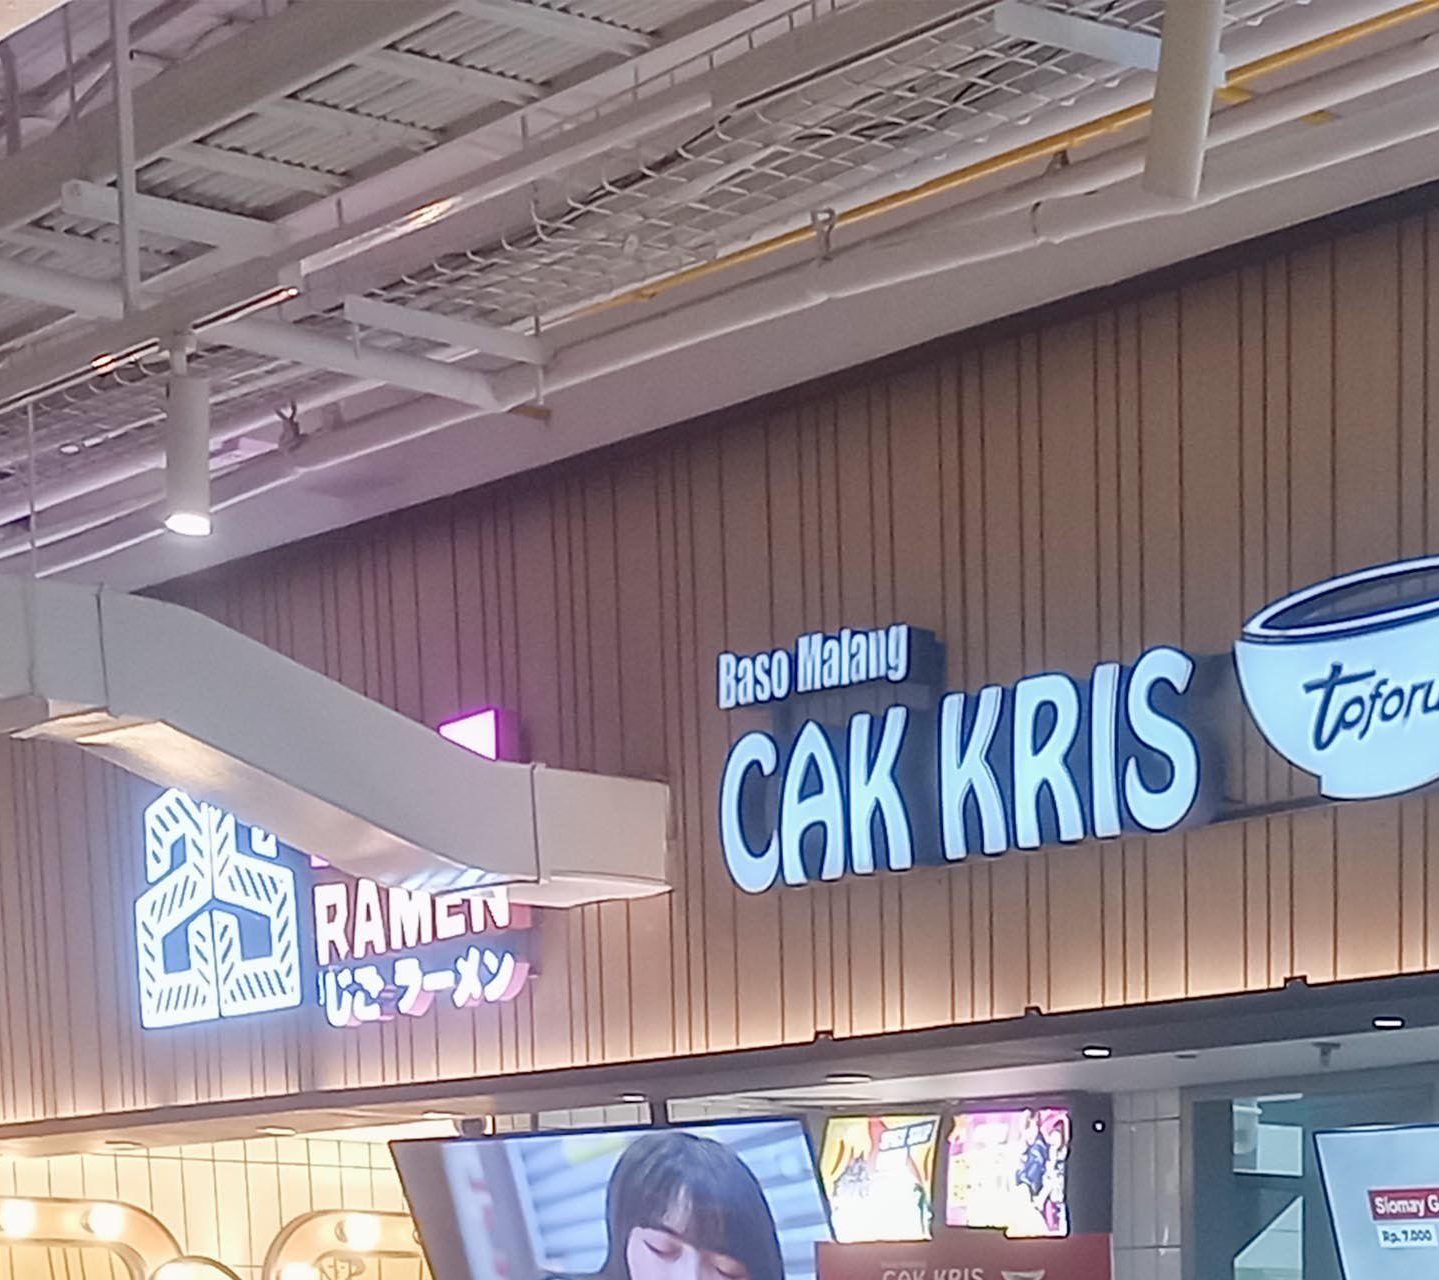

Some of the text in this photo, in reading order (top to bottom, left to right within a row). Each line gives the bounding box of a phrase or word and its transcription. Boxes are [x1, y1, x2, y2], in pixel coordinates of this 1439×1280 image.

[718, 623, 908, 710] Baso Malang
[720, 645, 1200, 895] CAK KRIS
[313, 878, 510, 966] RAMEN
[1373, 1196, 1425, 1217] Siomay
